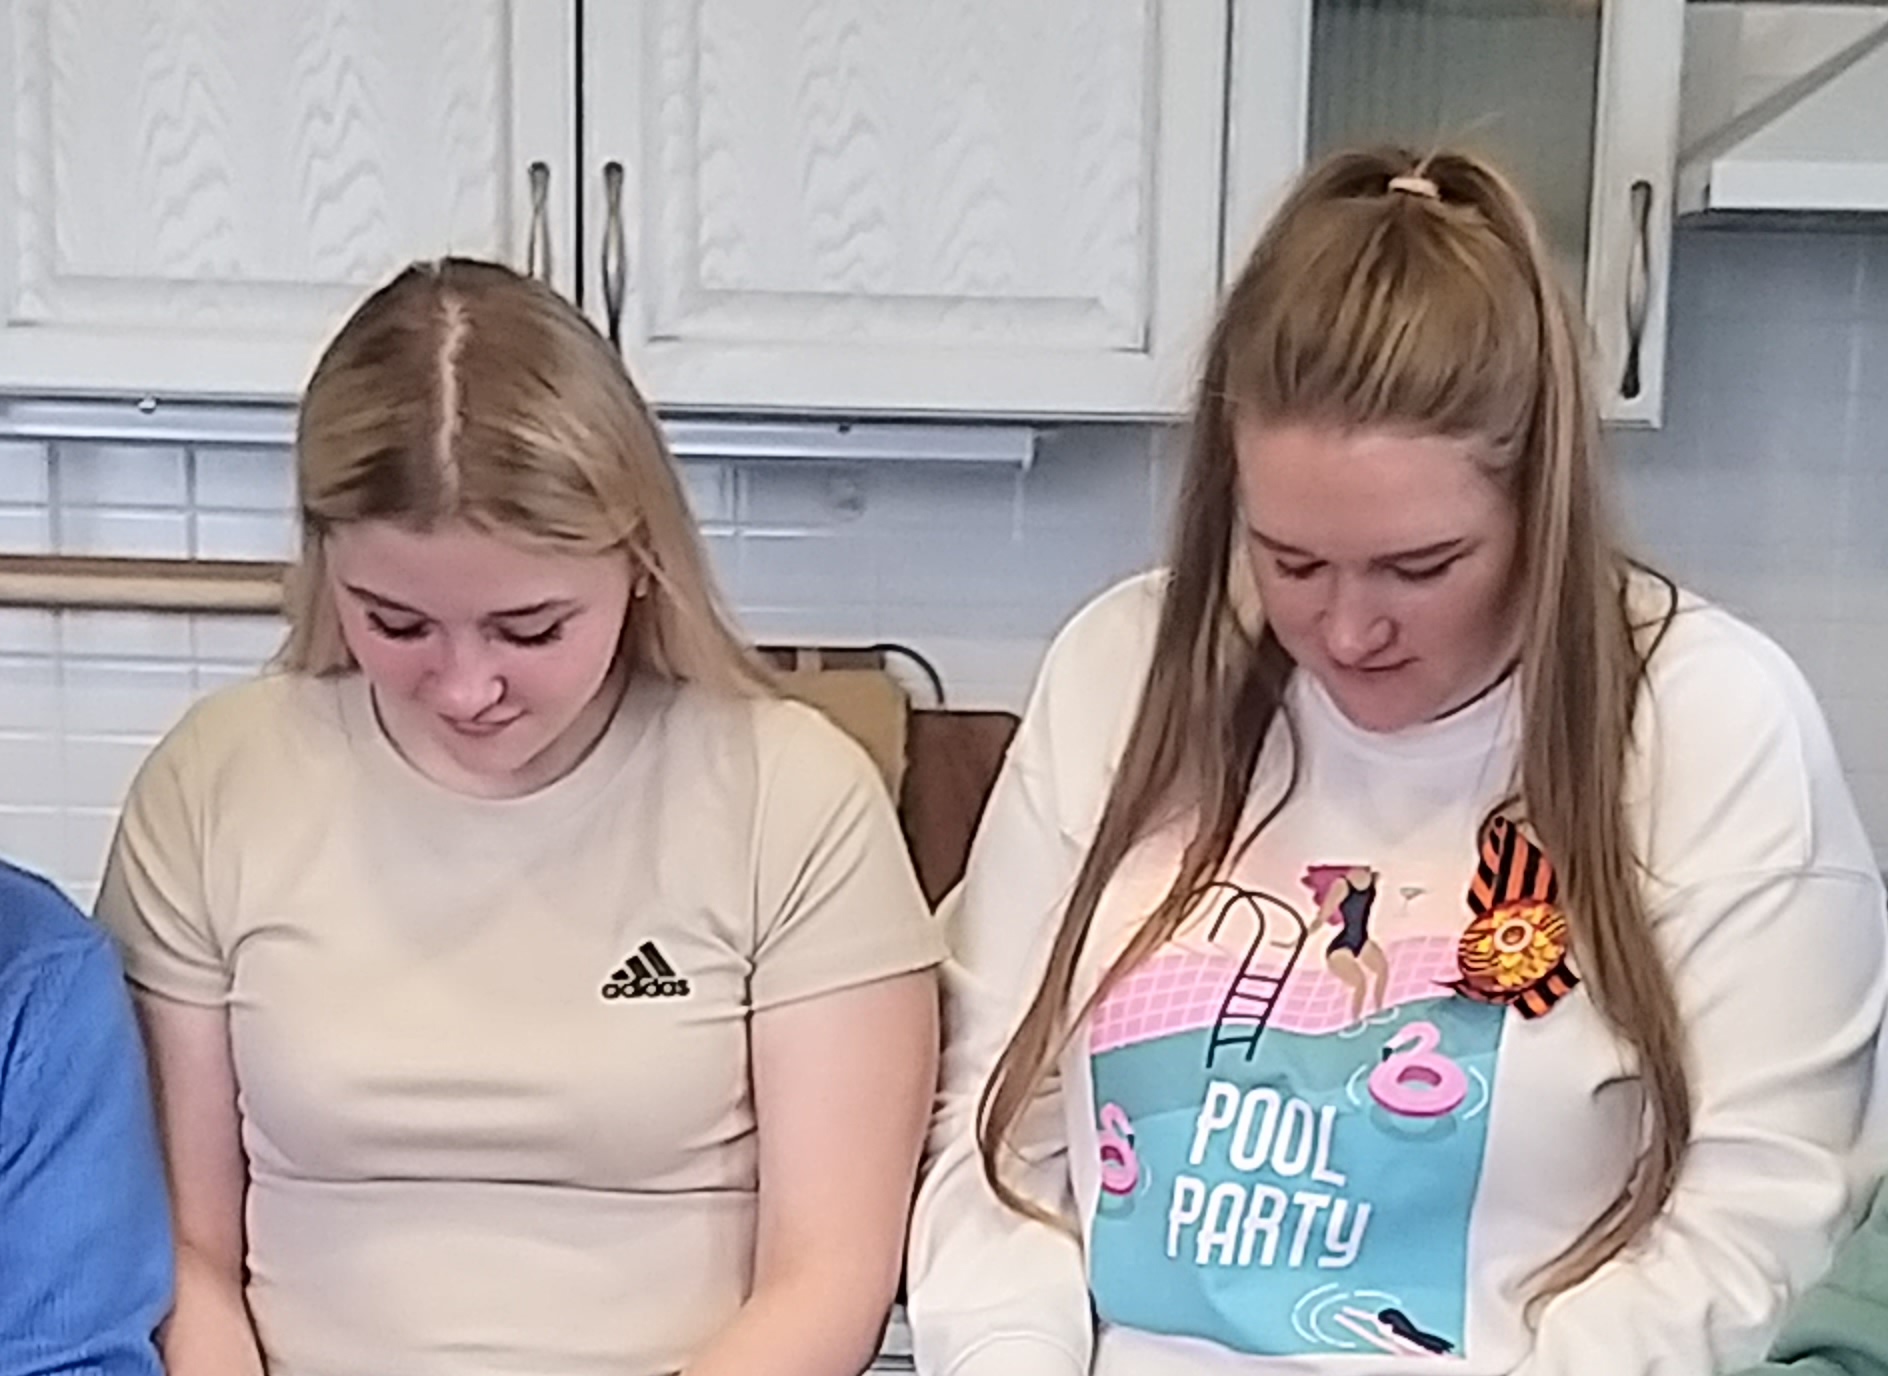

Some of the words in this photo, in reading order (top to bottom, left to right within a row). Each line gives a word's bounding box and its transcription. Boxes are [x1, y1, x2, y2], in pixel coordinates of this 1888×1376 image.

[602, 979, 691, 999] adidas
[1189, 1081, 1347, 1186] POOL
[1166, 1176, 1373, 1268] PARTY
